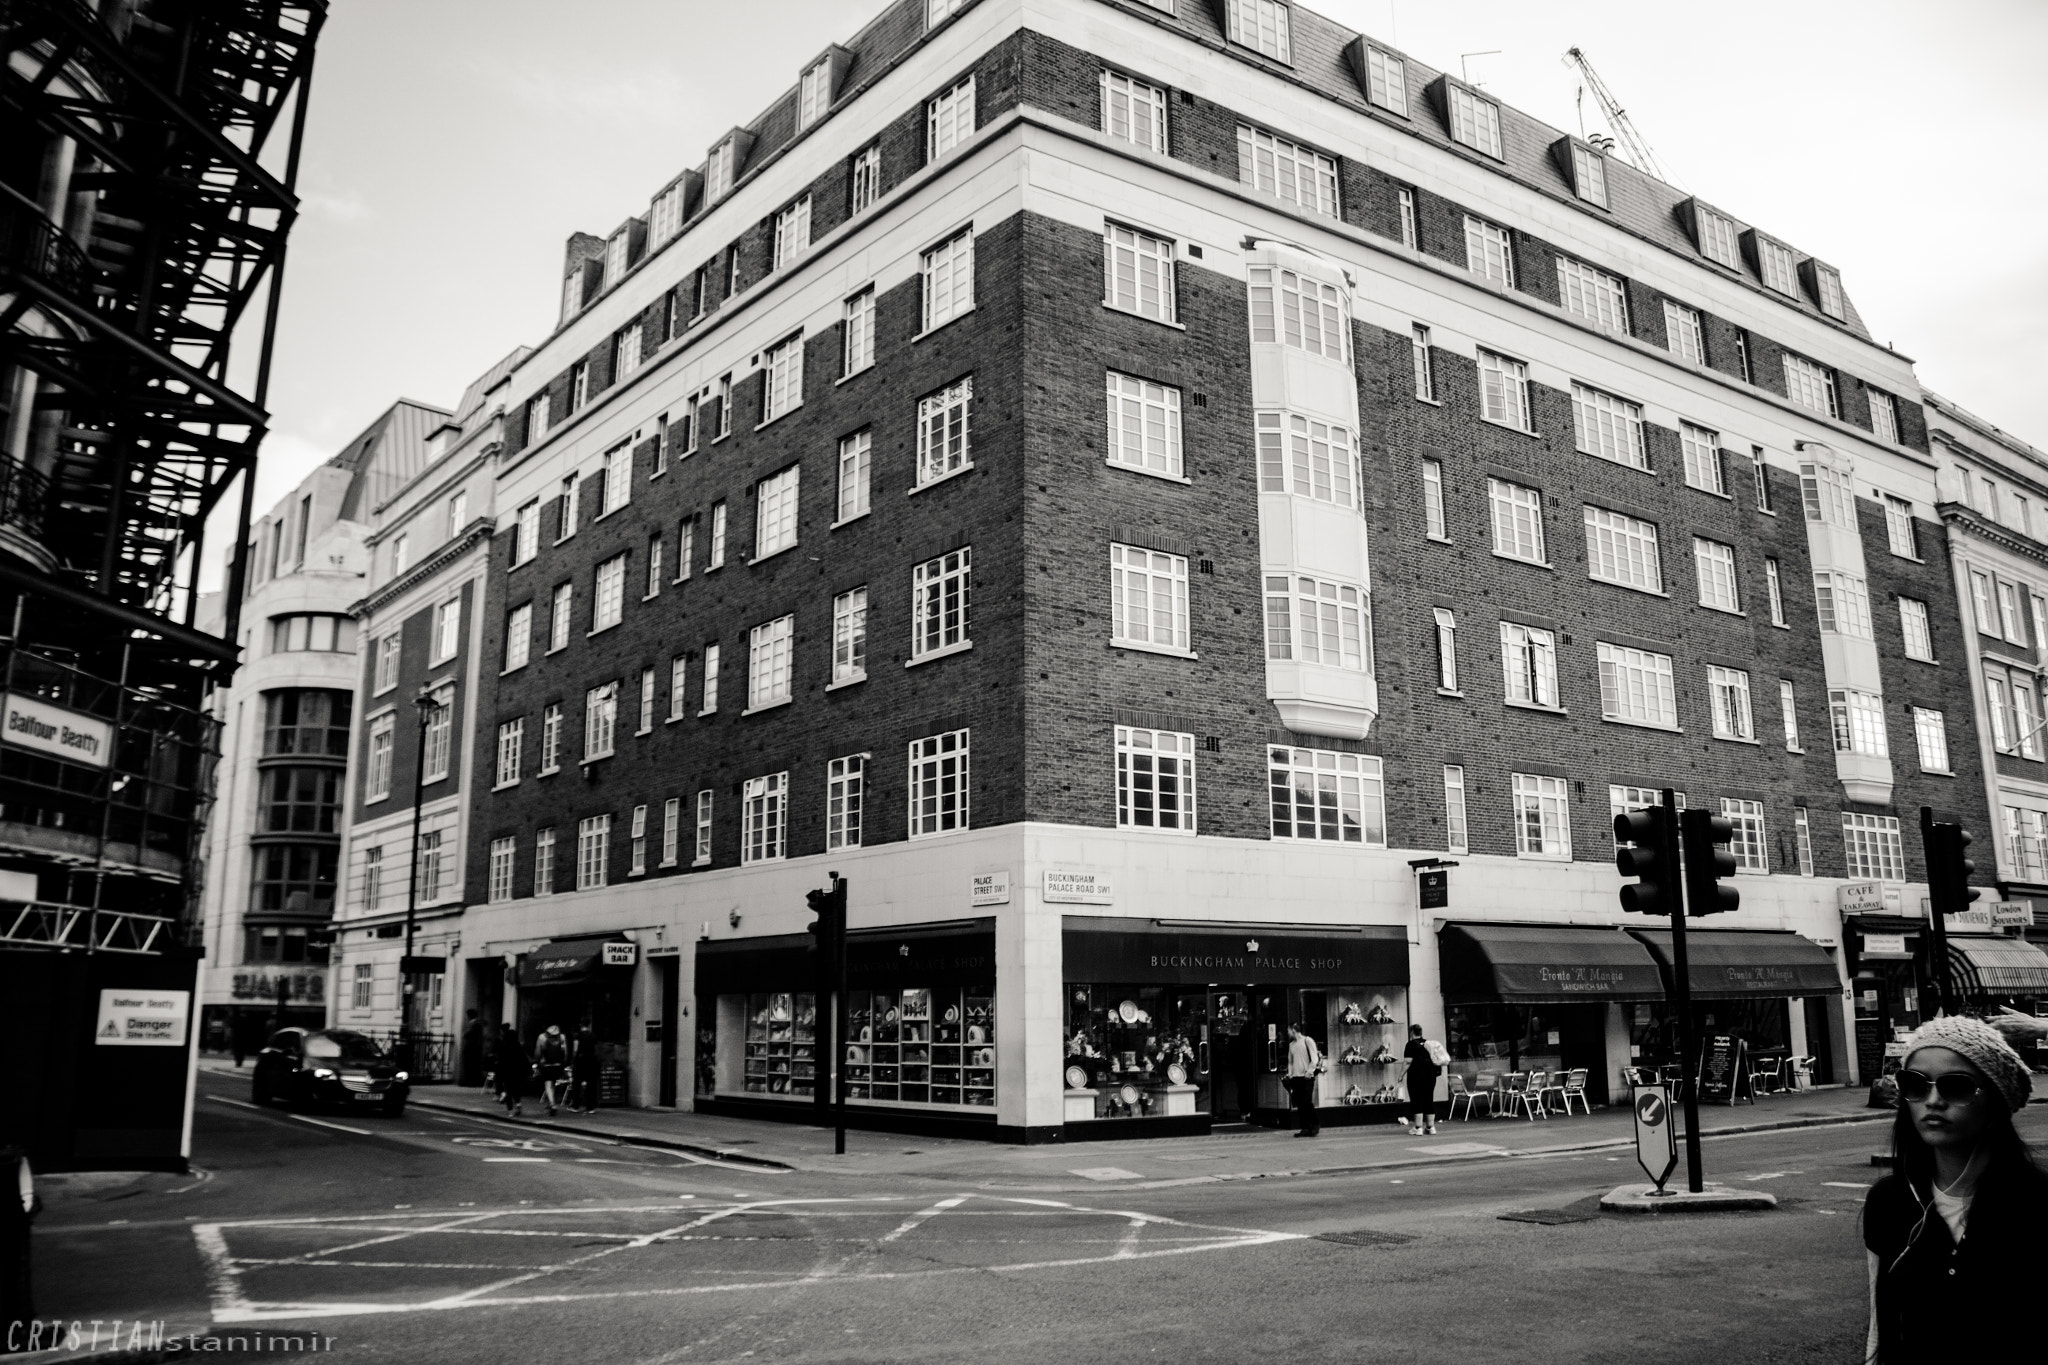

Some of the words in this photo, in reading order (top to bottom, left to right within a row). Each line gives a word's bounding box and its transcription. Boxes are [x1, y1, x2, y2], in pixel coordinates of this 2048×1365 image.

[9, 711, 57, 740] Balfour
[61, 726, 99, 756] Beatty
[973, 876, 992, 886] PALACE
[1048, 873, 1095, 884] BUCKINGHAM
[973, 886, 992, 895] STREET
[1048, 883, 1073, 893] PALACE
[1075, 885, 1095, 894] ROAD
[1097, 885, 1111, 895] SW1
[1844, 901, 1881, 910] TAKEAWAY
[607, 946, 633, 954] SNACK
[611, 955, 628, 963] BAR
[1151, 956, 1244, 968] BUCKINGHAM
[1255, 957, 1300, 969] PALACE
[1310, 958, 1342, 969] SHOP
[1540, 967, 1571, 981] Pronto
[1590, 967, 1623, 985] Mangia
[127, 1019, 172, 1032] Danger
